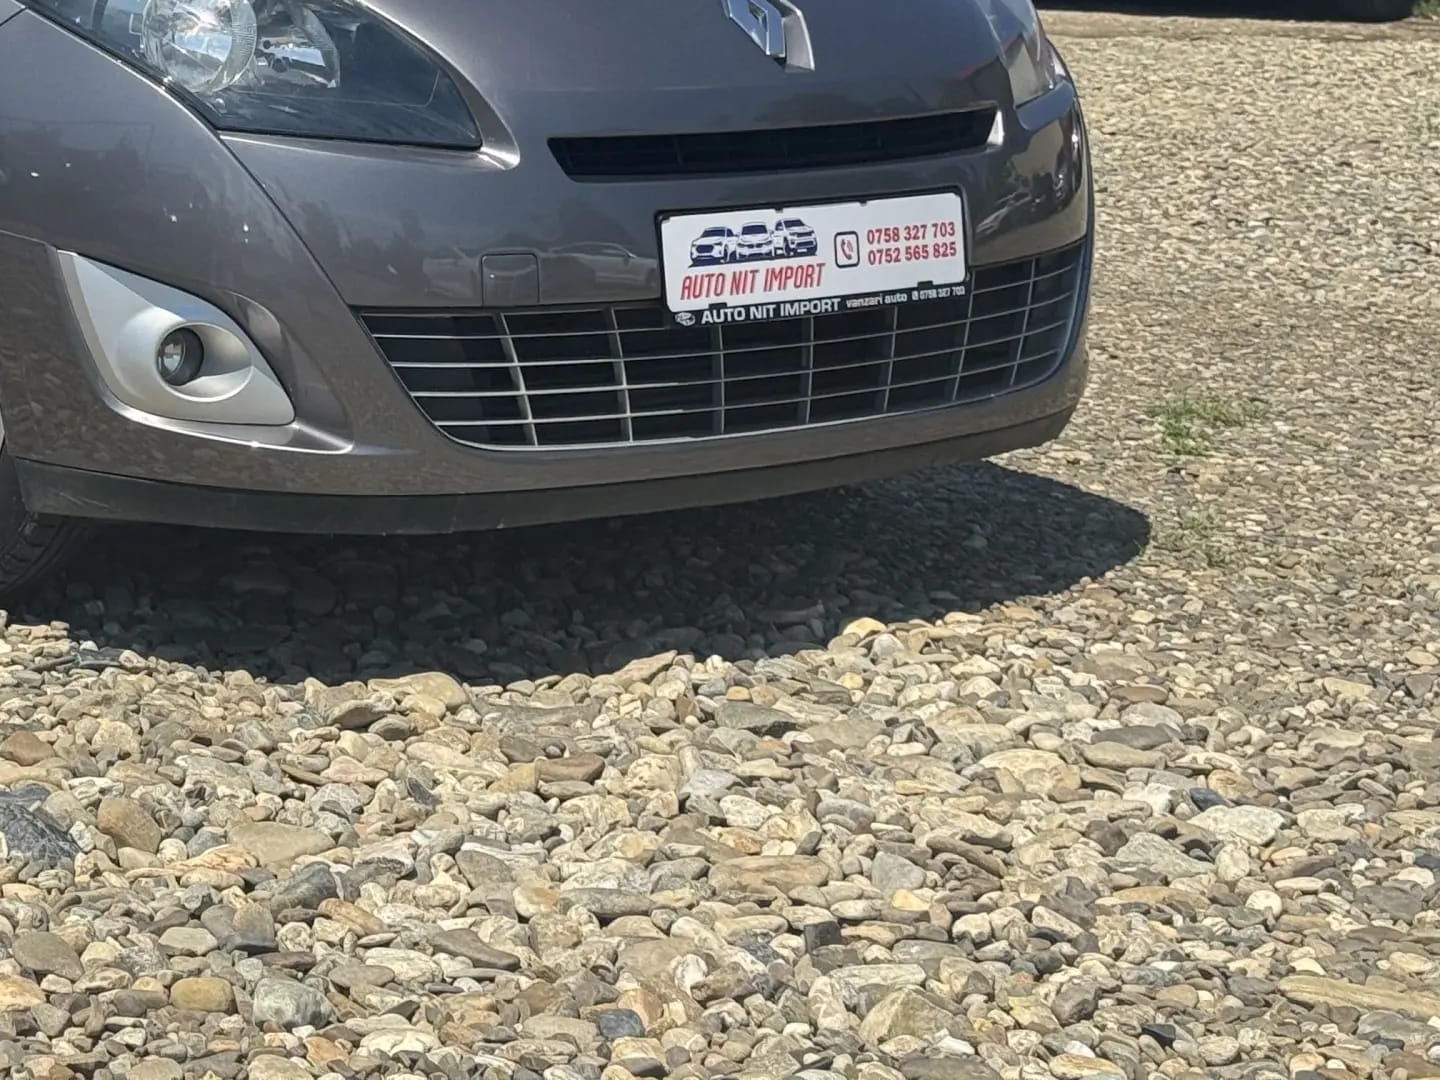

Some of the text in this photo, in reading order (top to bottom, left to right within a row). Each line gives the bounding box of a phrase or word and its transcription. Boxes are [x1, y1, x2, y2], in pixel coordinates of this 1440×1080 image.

[866, 221, 956, 245] 0758 327 703
[867, 241, 957, 266] 0752 565 825
[680, 262, 826, 301] AUTO NIT IMPORT
[700, 306, 747, 325] AUTO
[749, 303, 777, 320] NIT
[779, 298, 841, 317] IMPORT
[846, 293, 883, 309] vanzari
[884, 292, 908, 305] auto
